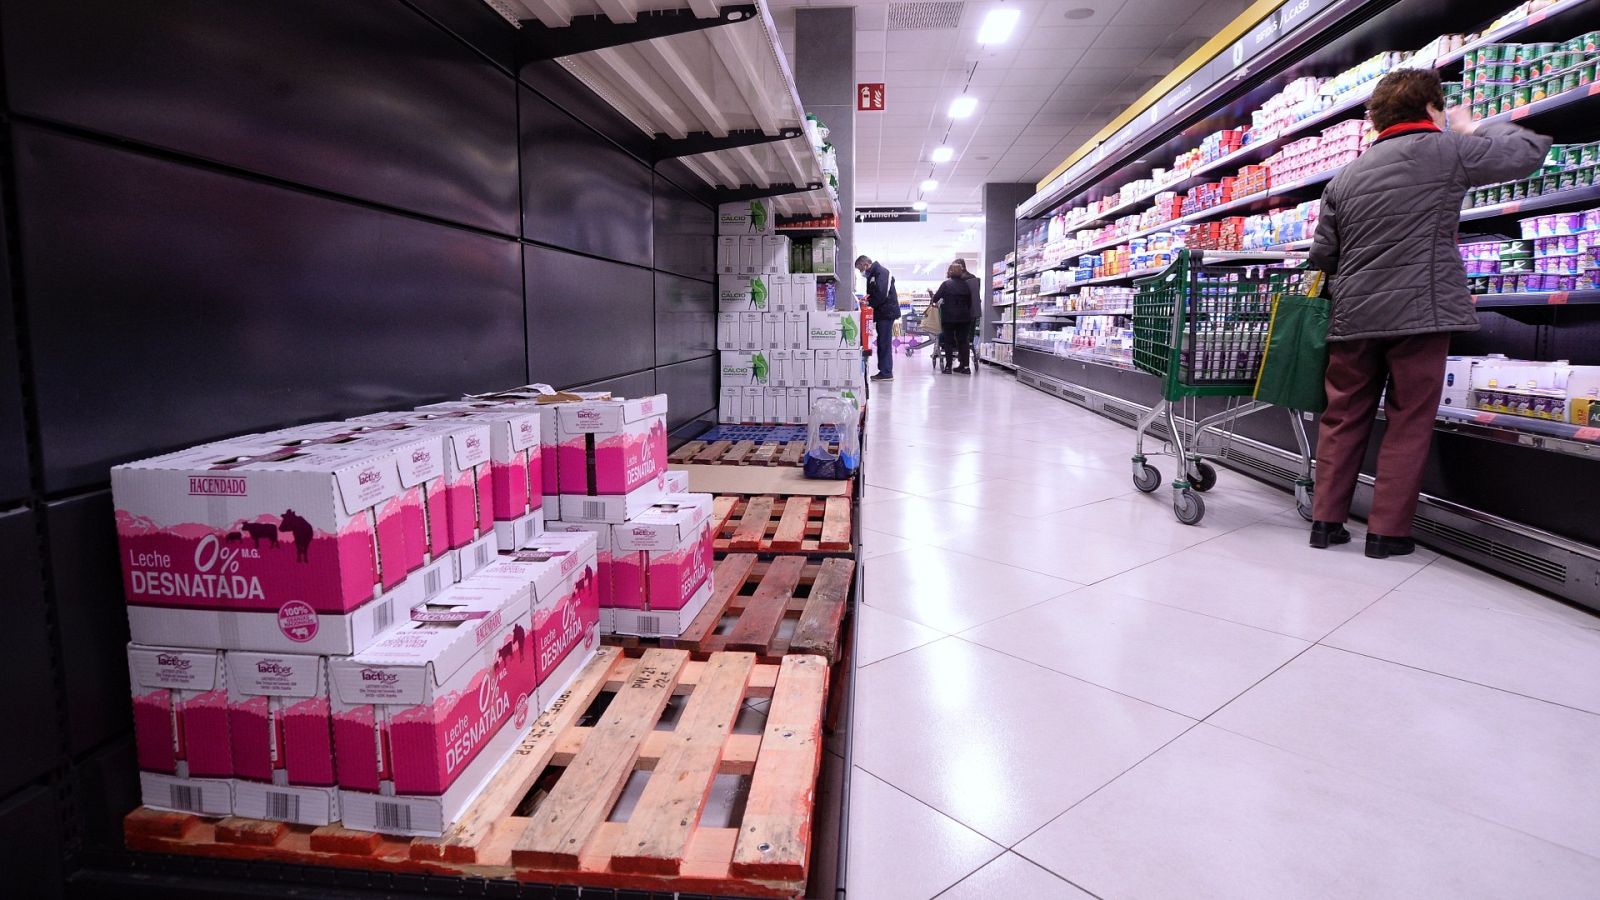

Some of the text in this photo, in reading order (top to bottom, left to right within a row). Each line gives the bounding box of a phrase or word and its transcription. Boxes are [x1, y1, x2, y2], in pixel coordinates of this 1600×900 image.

[189, 478, 246, 494] HACENDADO
[130, 533, 261, 574] Leche 0% M.G.
[131, 570, 265, 600] DESNATADA
[284, 605, 308, 617] 100%
[541, 617, 583, 672] DESNATADA
[479, 673, 500, 713] 0%
[444, 714, 469, 748] Leche
[445, 691, 510, 775] DESNATADA
